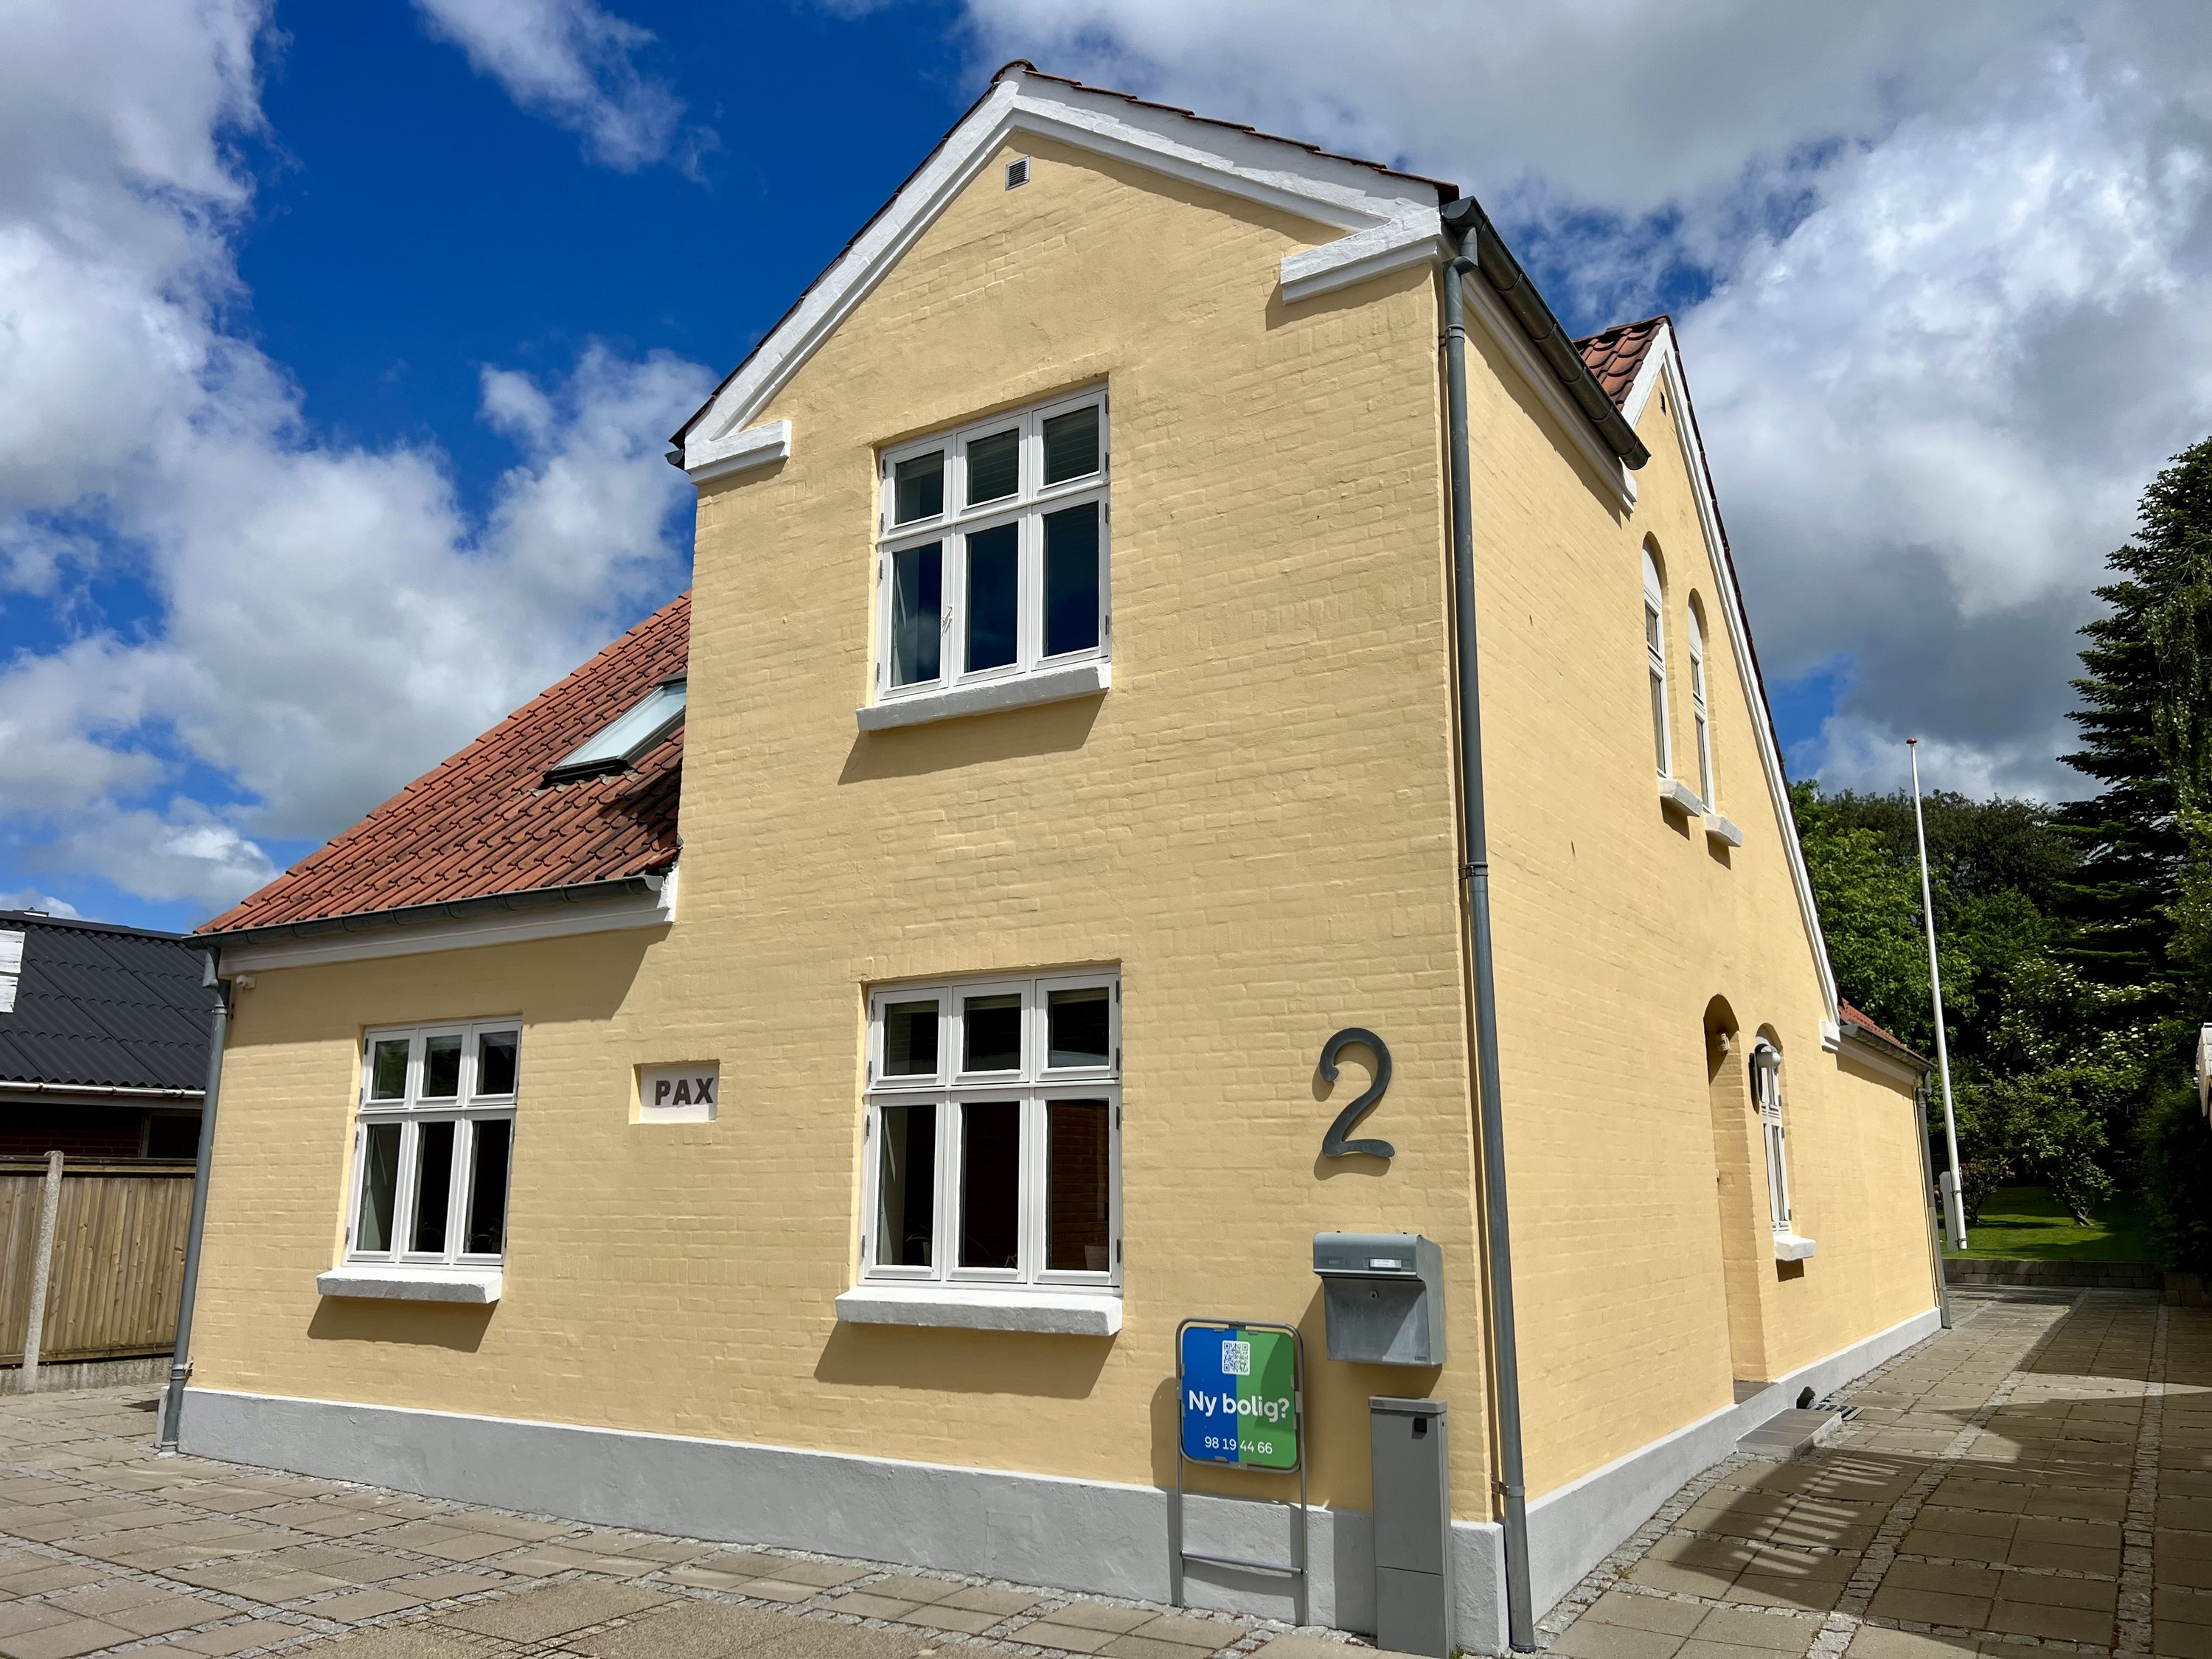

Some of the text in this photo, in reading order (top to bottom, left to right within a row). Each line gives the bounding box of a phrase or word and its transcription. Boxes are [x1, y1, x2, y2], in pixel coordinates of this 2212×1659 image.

[655, 1077, 714, 1106] PAX
[1319, 1027, 1395, 1157] 2
[1189, 1389, 1290, 1422] Ny bolig?
[1204, 1436, 1273, 1454] 98 19 44 66
